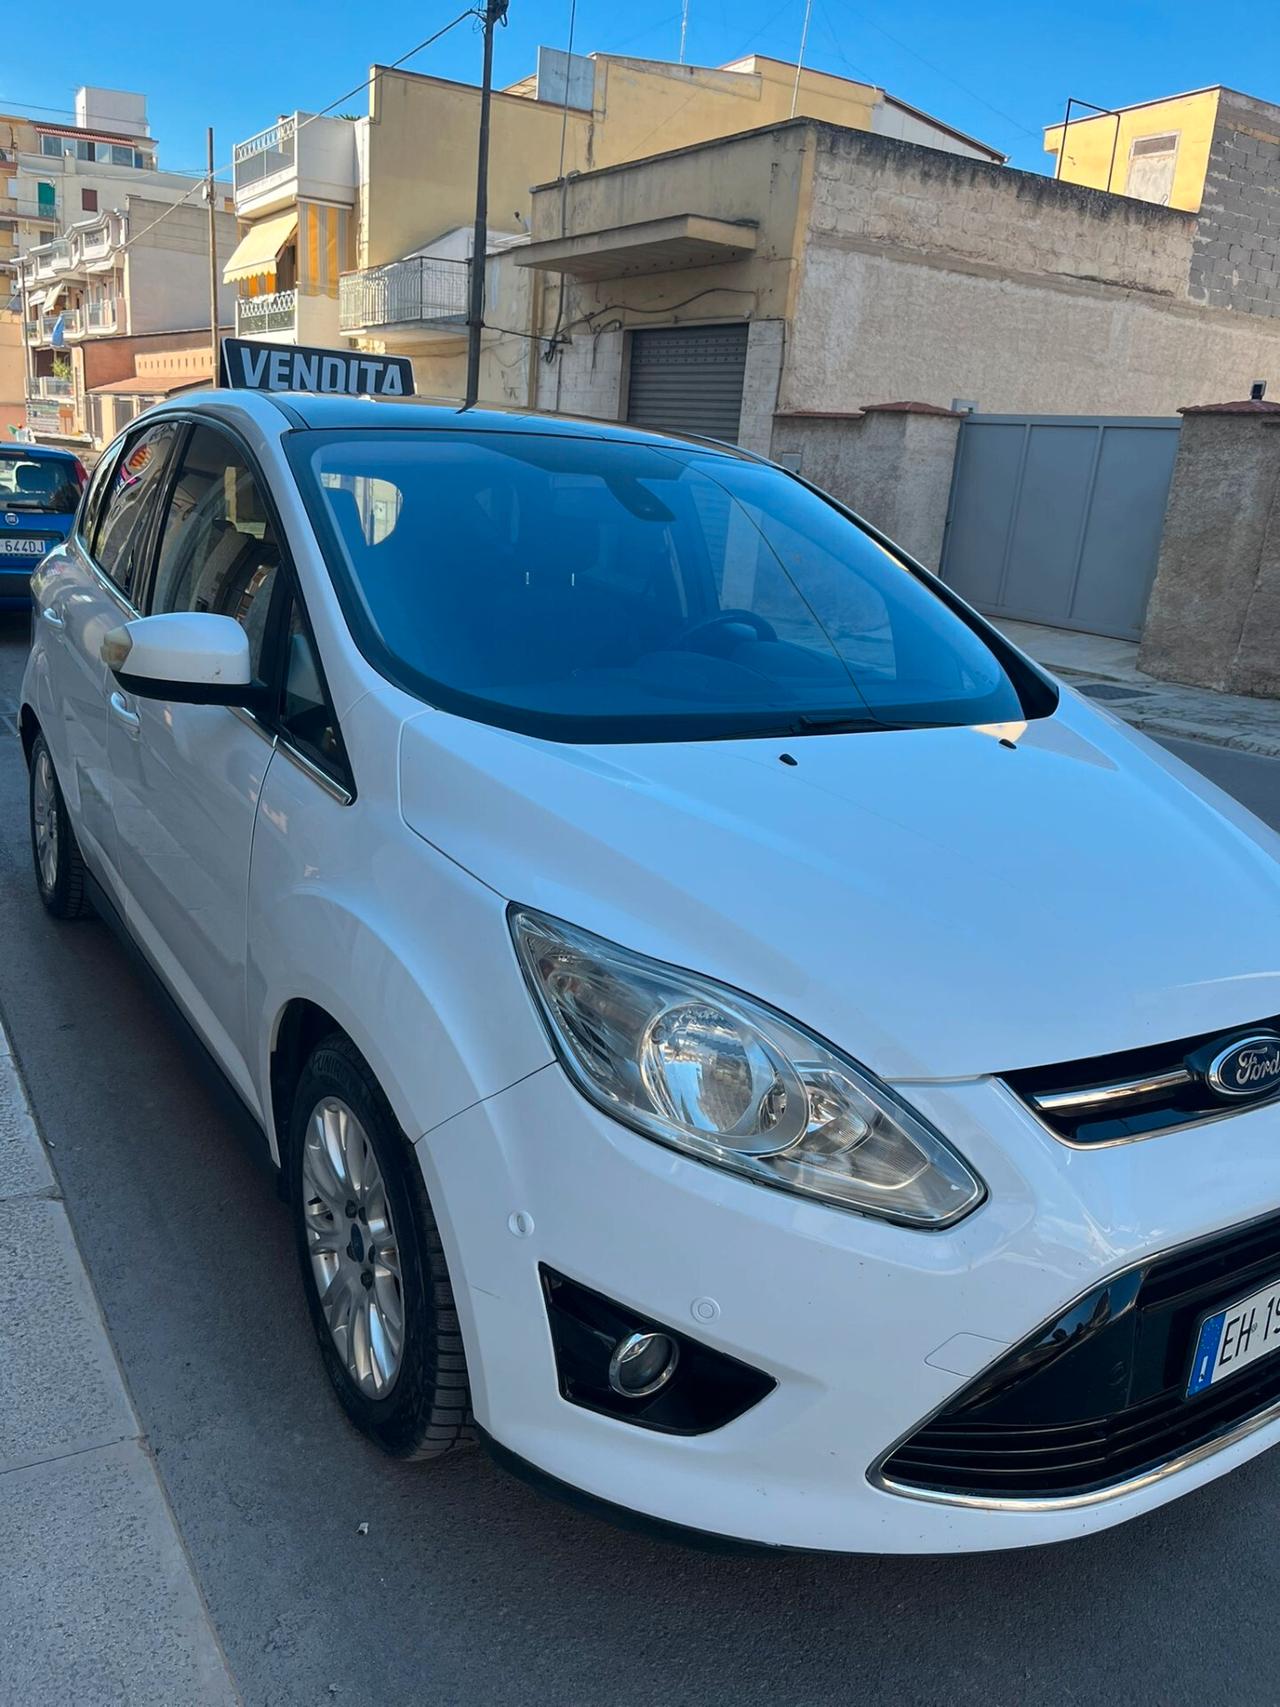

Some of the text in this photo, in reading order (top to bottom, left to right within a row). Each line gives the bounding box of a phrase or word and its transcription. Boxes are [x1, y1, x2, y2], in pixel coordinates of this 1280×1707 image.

[240, 347, 404, 396] VENDITA
[5, 540, 44, 553] 644DJ
[1236, 1046, 1280, 1085] Ford
[1218, 1307, 1256, 1367] EH
